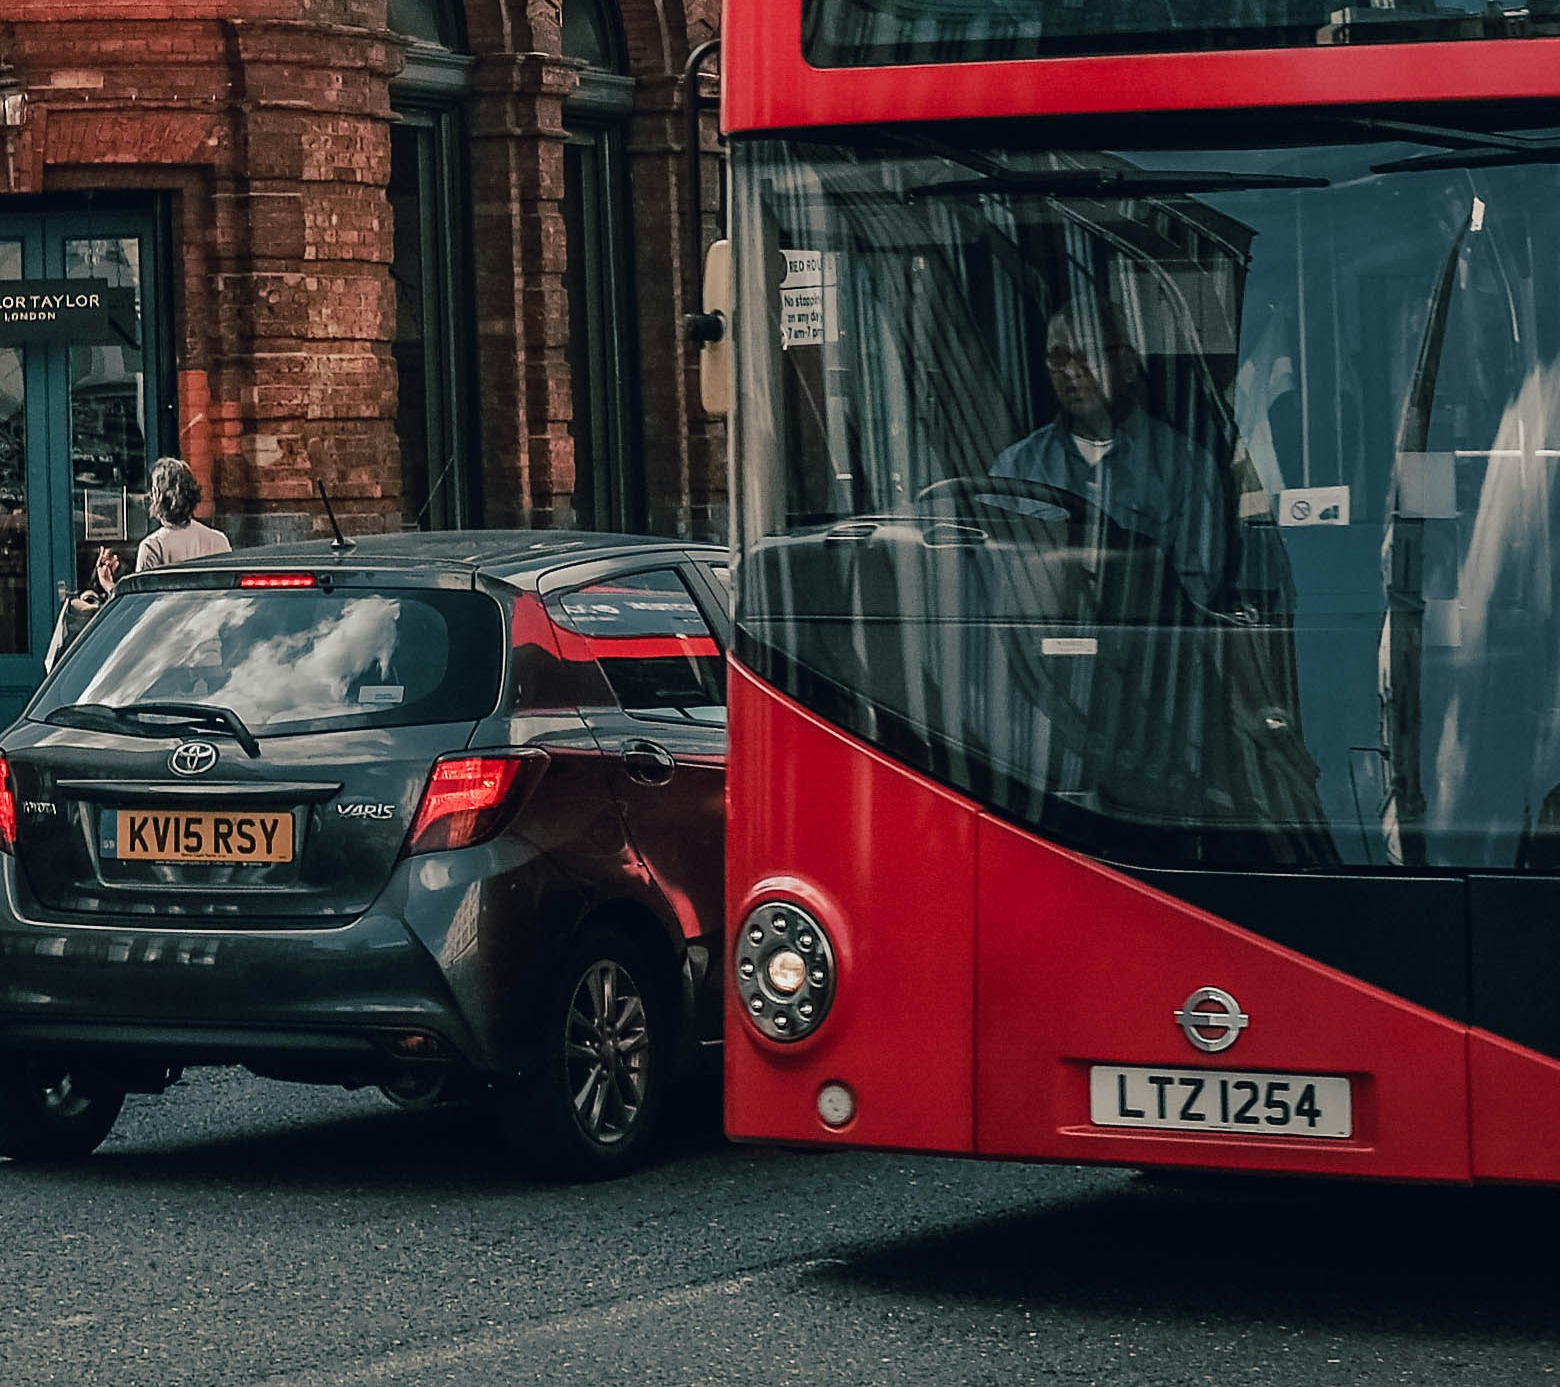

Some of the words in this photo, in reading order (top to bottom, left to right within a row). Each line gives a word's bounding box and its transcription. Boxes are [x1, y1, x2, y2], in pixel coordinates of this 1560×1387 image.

[29, 293, 100, 309] TAYLOR
[4, 311, 56, 323] LONDON
[129, 816, 203, 854] KV15
[213, 818, 280, 855] RSY
[1115, 1073, 1205, 1125] LTZ
[1217, 1076, 1322, 1130] 1254
